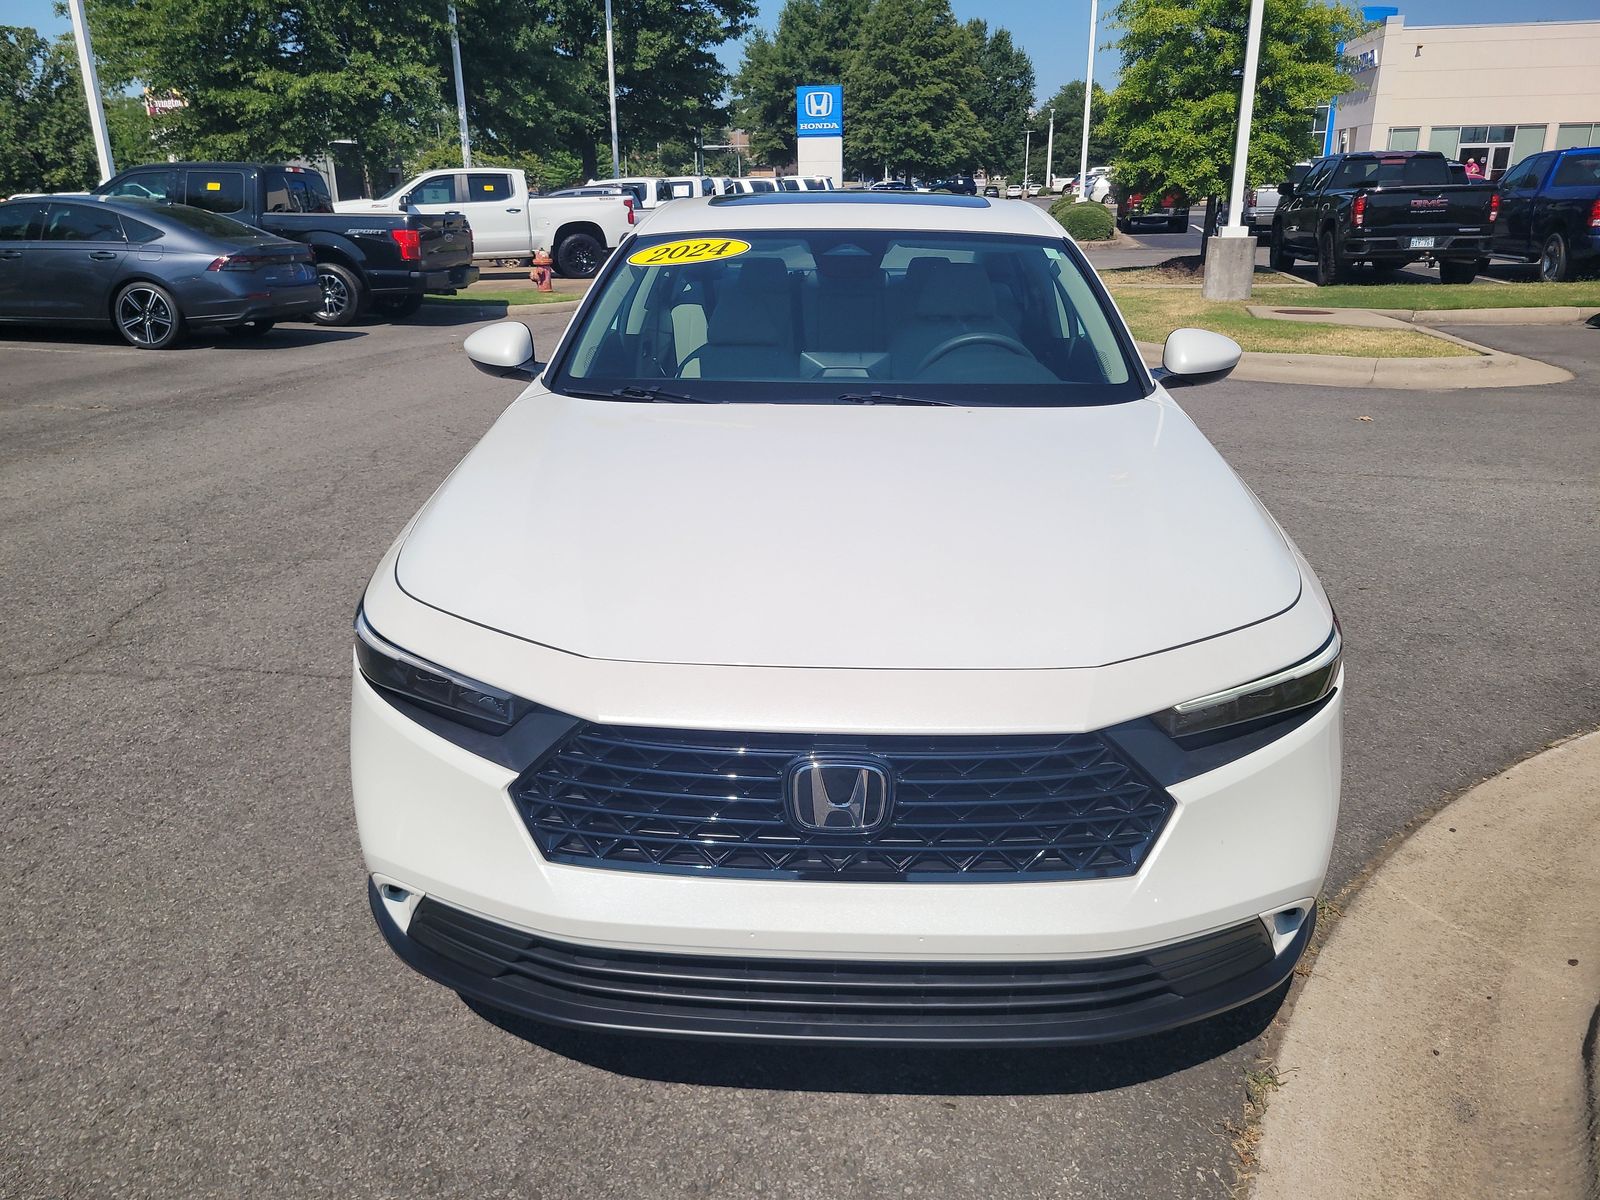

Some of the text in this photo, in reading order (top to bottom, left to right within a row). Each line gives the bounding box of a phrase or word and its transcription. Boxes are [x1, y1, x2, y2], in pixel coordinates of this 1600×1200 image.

[799, 122, 840, 130] HONDA
[1410, 198, 1449, 208] GMC
[646, 241, 732, 263] 2024
